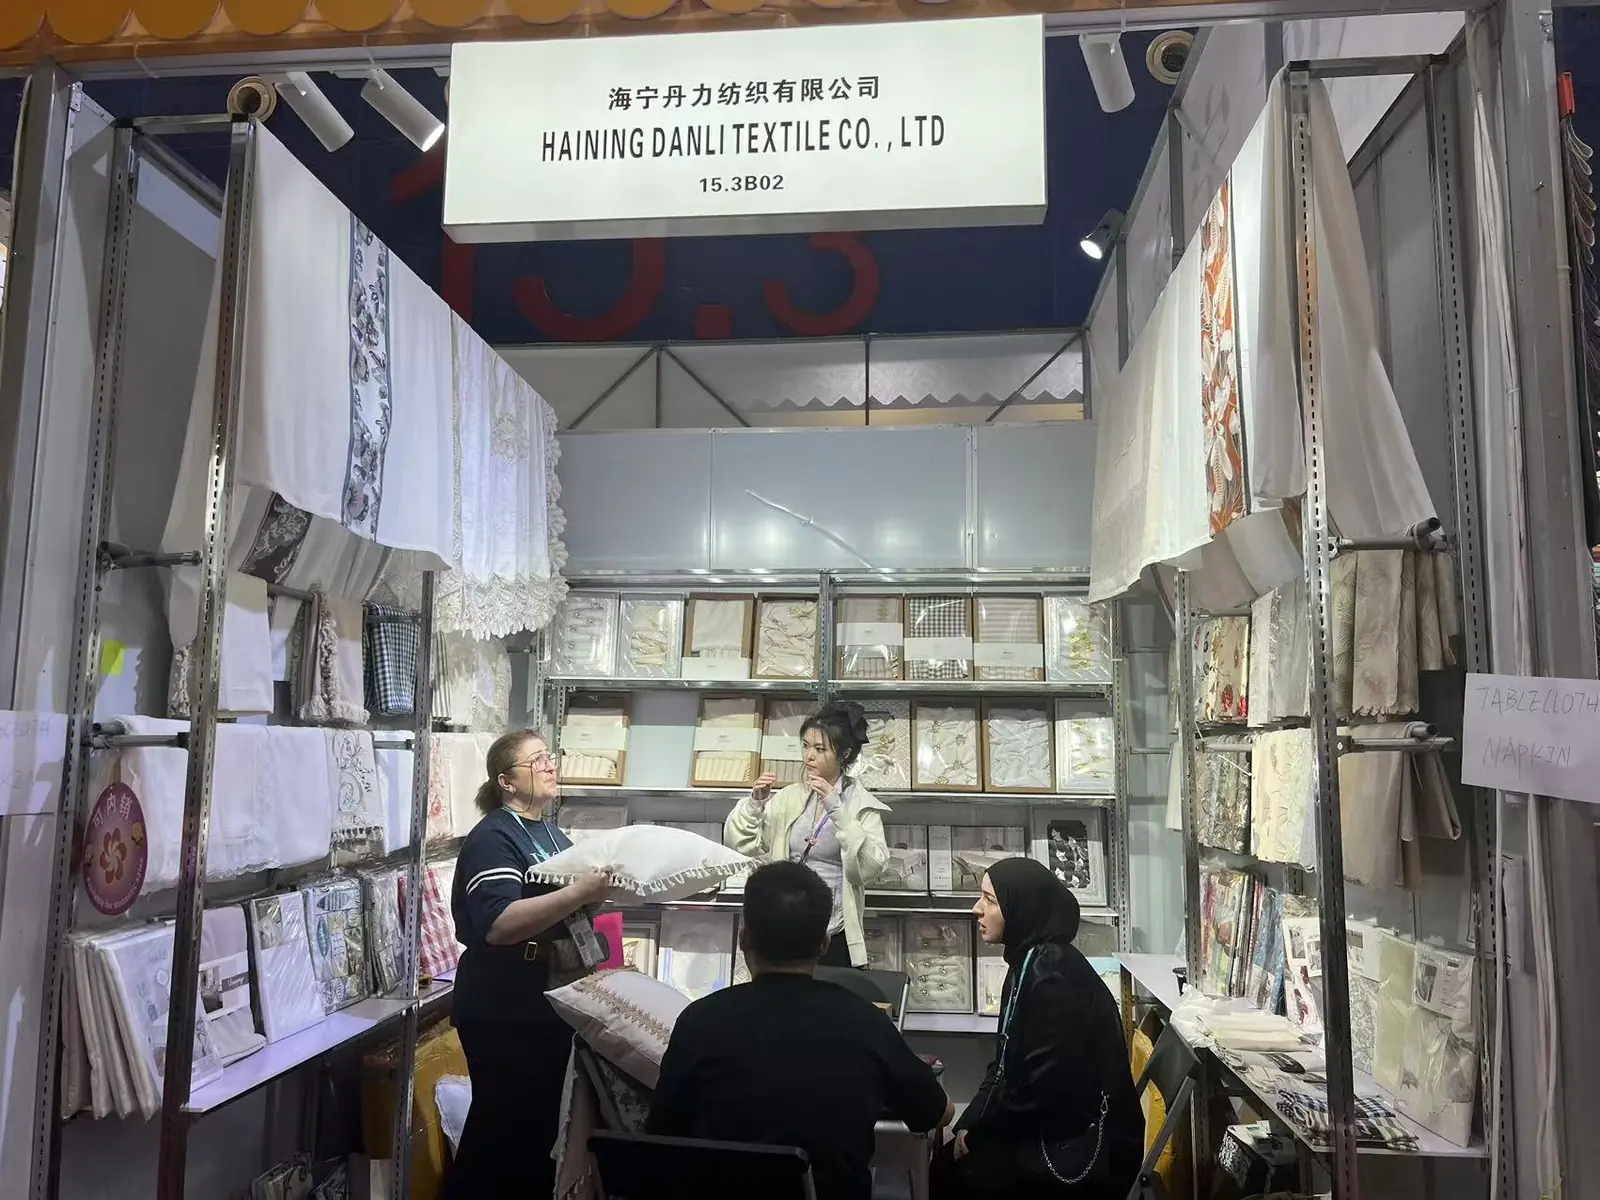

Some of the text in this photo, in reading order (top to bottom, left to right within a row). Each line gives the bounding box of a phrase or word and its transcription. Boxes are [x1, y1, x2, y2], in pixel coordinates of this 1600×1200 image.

[608, 75, 879, 110] 海宁丹力纺织有限公司
[542, 127, 644, 162] HAINING
[652, 124, 724, 158] DANLI
[732, 119, 830, 154] TEXTILE
[699, 174, 784, 193] 15.3B02
[1475, 686, 1600, 716] TABLECLOTH
[1482, 736, 1571, 781] NAPKIN
